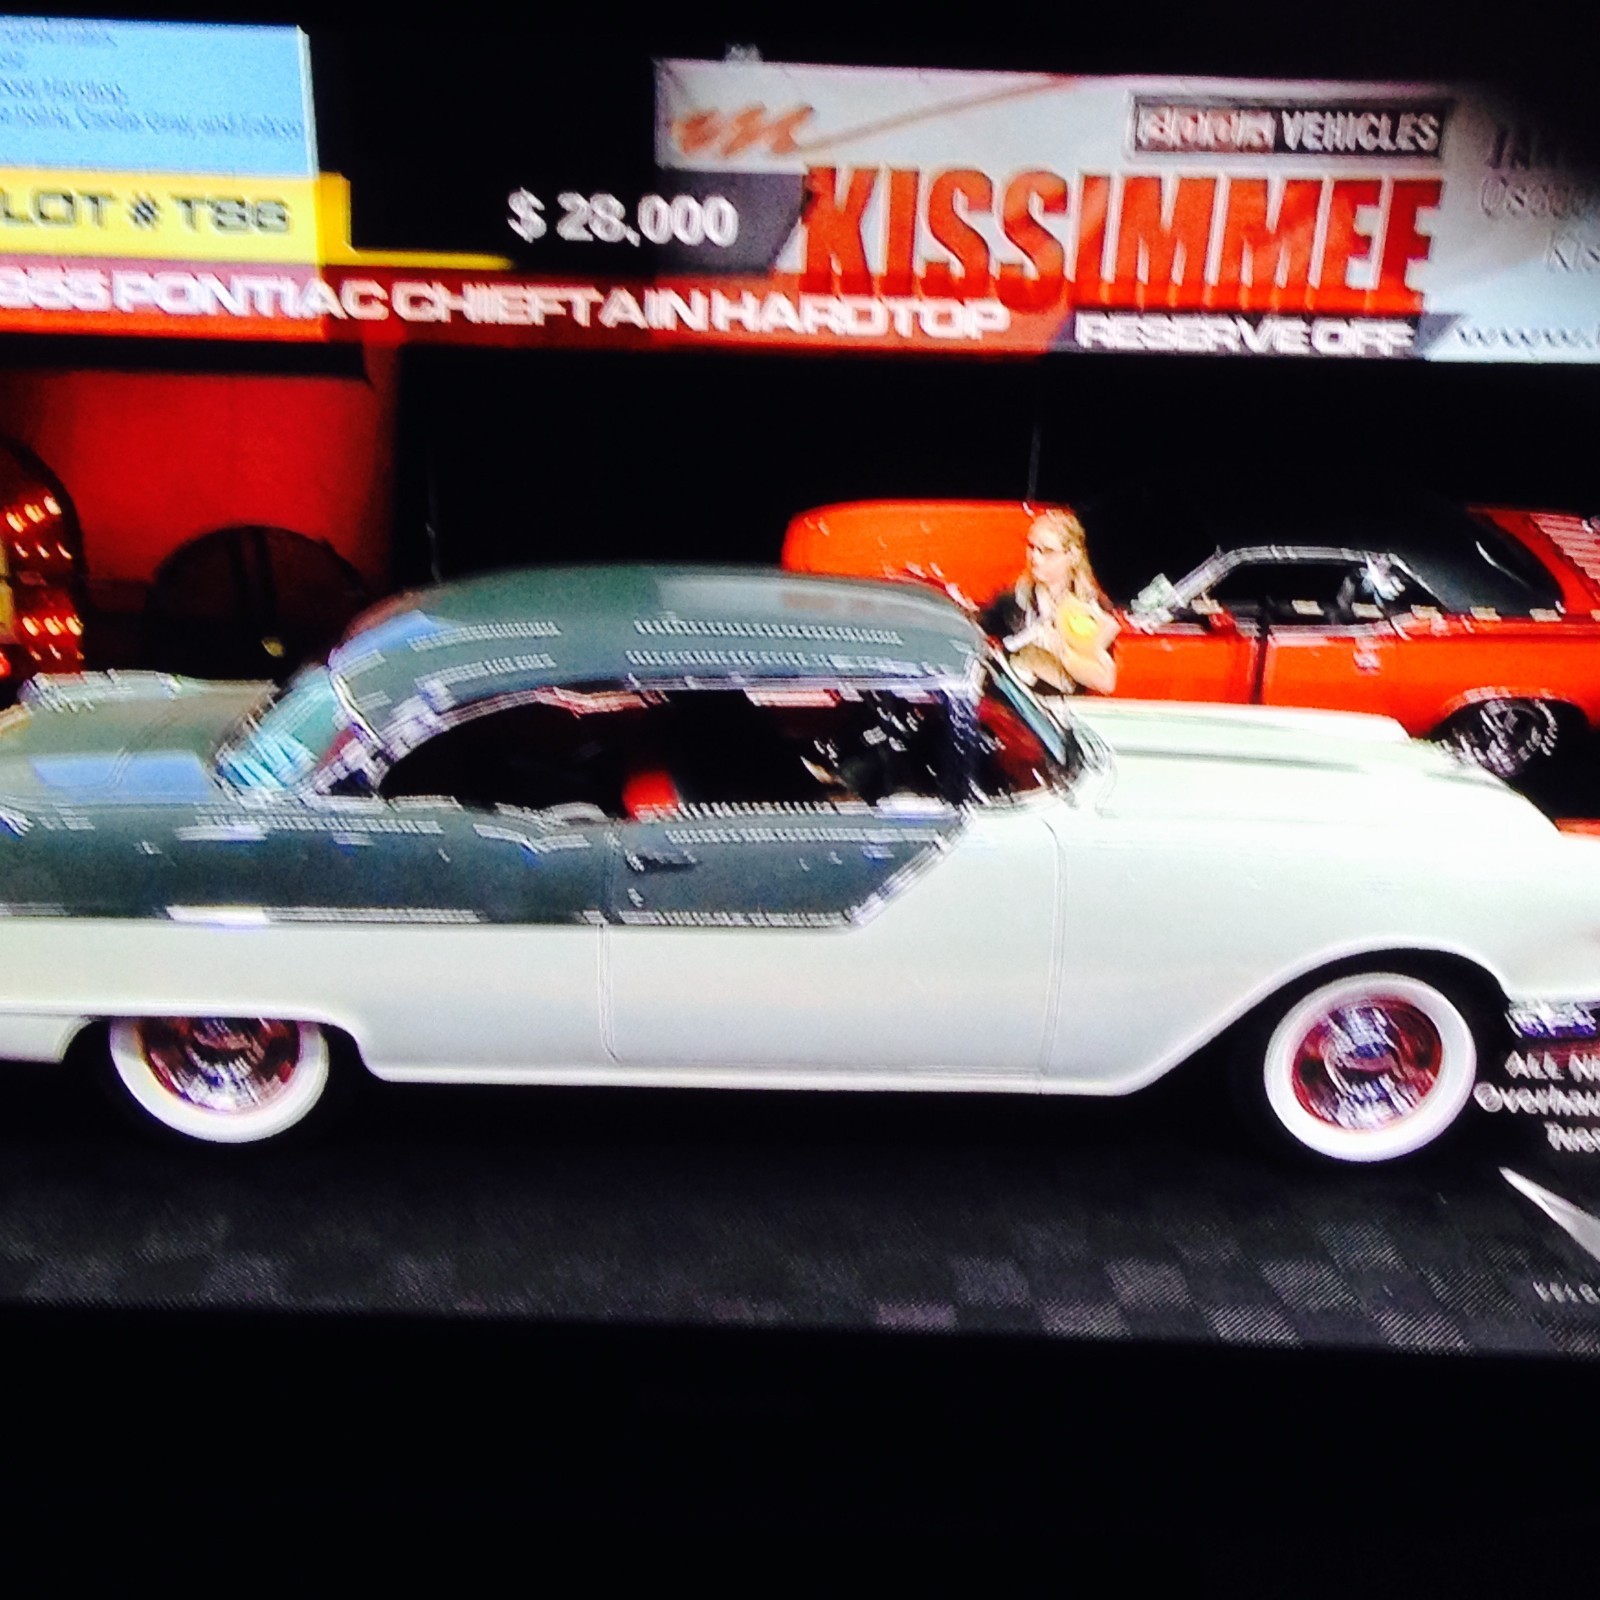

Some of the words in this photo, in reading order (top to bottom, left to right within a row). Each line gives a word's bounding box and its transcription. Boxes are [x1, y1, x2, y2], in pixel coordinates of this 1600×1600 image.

[1281, 110, 1440, 152] VEHICLES
[0, 188, 113, 228] LOT
[556, 191, 740, 248] 28,000
[803, 162, 1444, 312] KISSIMMEE
[111, 270, 389, 322] PONTIAC
[390, 278, 710, 333] CHIEFTAIN
[710, 290, 1011, 341] HARDTOP
[1074, 311, 1312, 354] RESERVE
[1311, 320, 1416, 358] OFF
